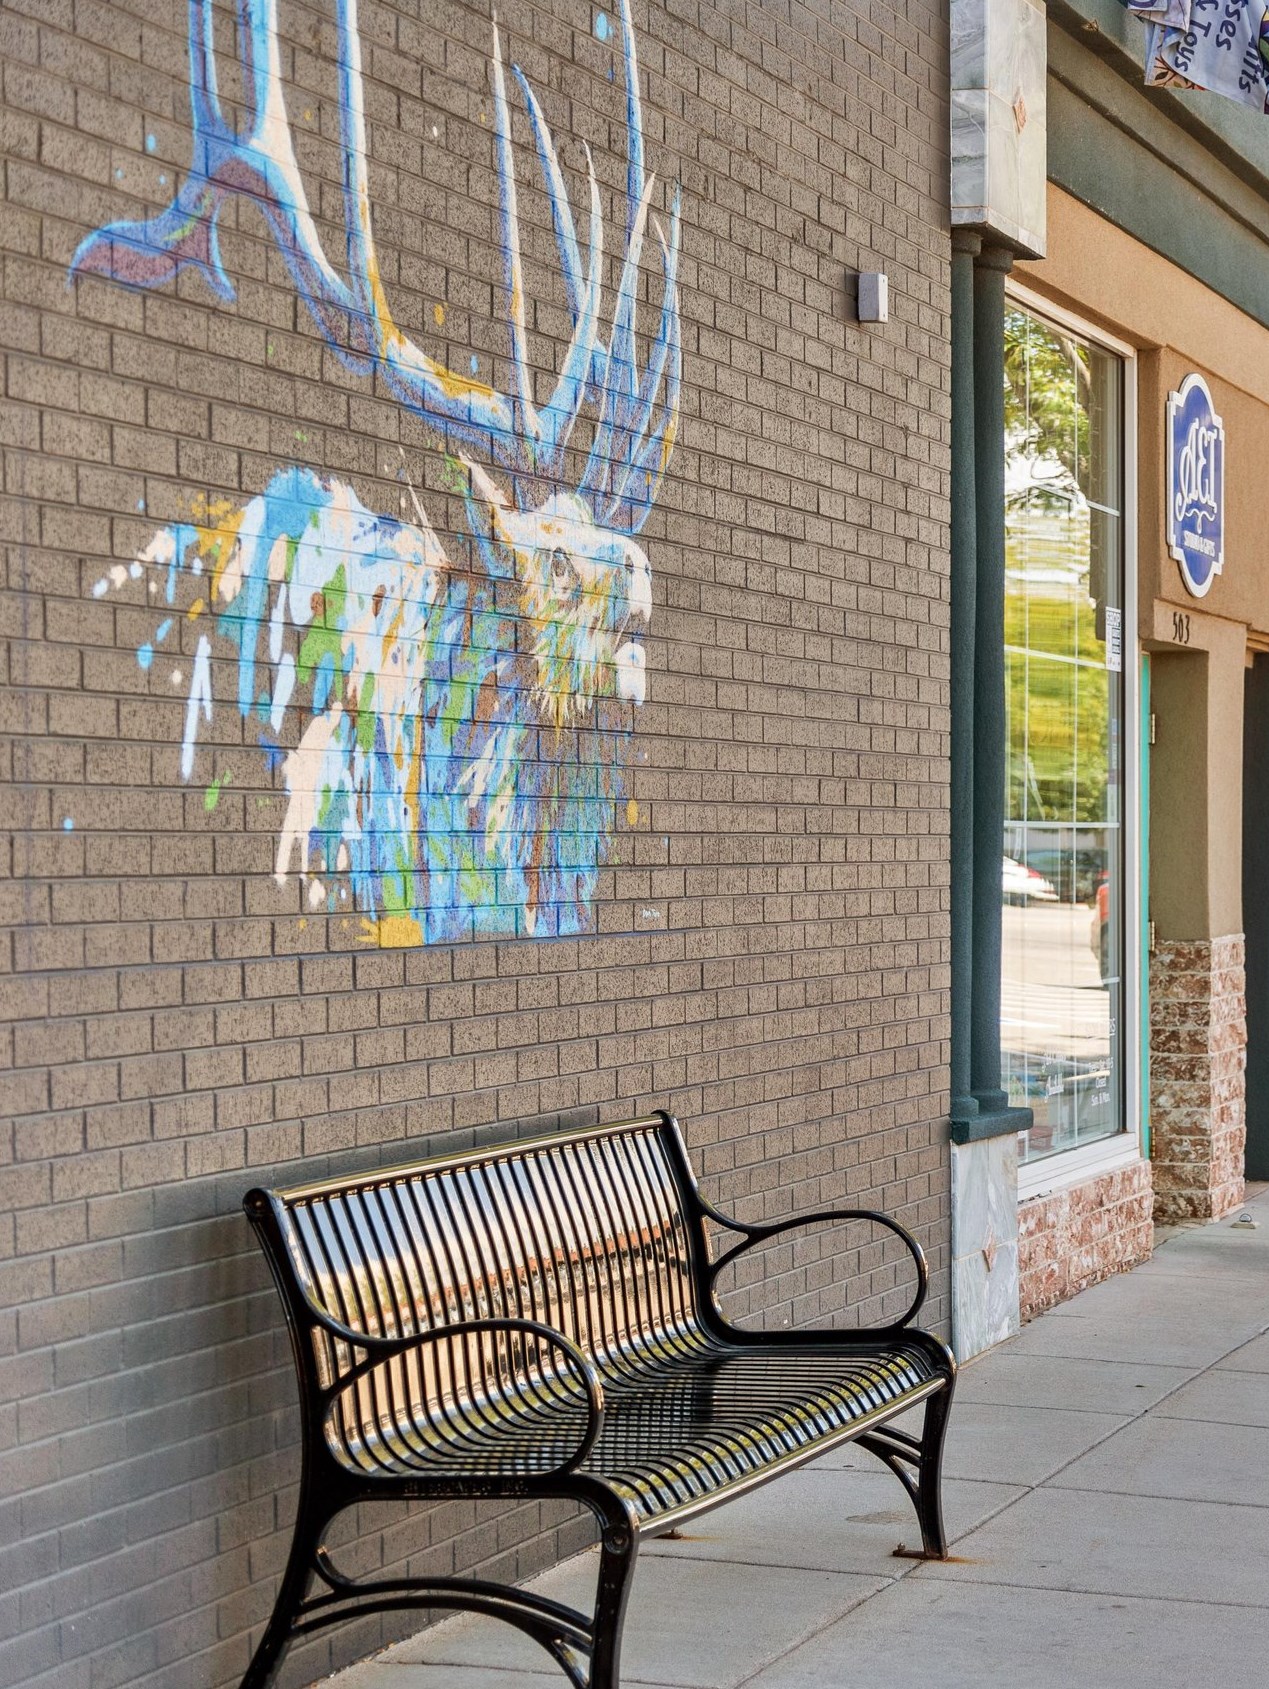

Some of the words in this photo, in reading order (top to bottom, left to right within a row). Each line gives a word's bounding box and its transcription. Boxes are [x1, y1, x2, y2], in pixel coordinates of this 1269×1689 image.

[1175, 20, 1212, 72] Toys
[1238, 37, 1262, 93] ifts
[1172, 611, 1190, 645] 503
